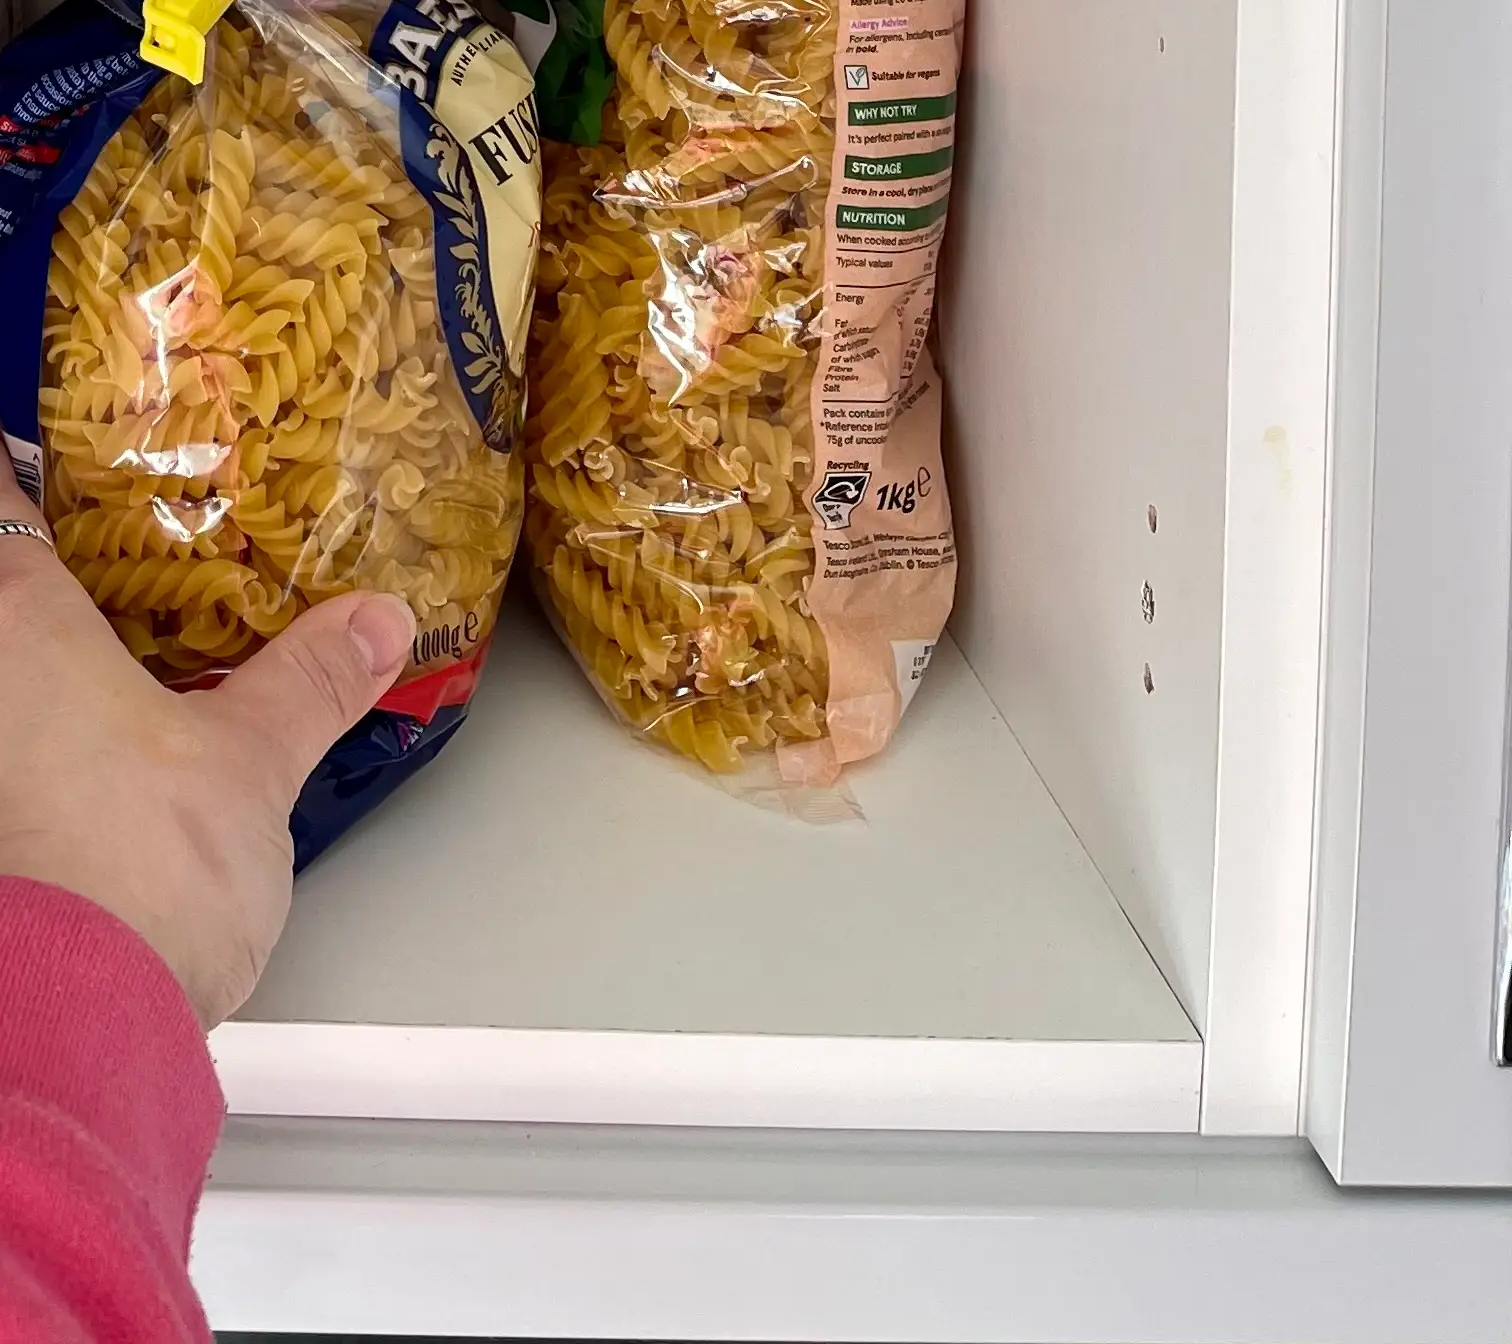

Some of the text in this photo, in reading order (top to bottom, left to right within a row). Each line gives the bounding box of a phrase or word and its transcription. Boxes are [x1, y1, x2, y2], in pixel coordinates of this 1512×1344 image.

[855, 104, 917, 120] WHY NOT TRY
[851, 162, 902, 175] STORAGE
[842, 211, 906, 226] NUTRITION
